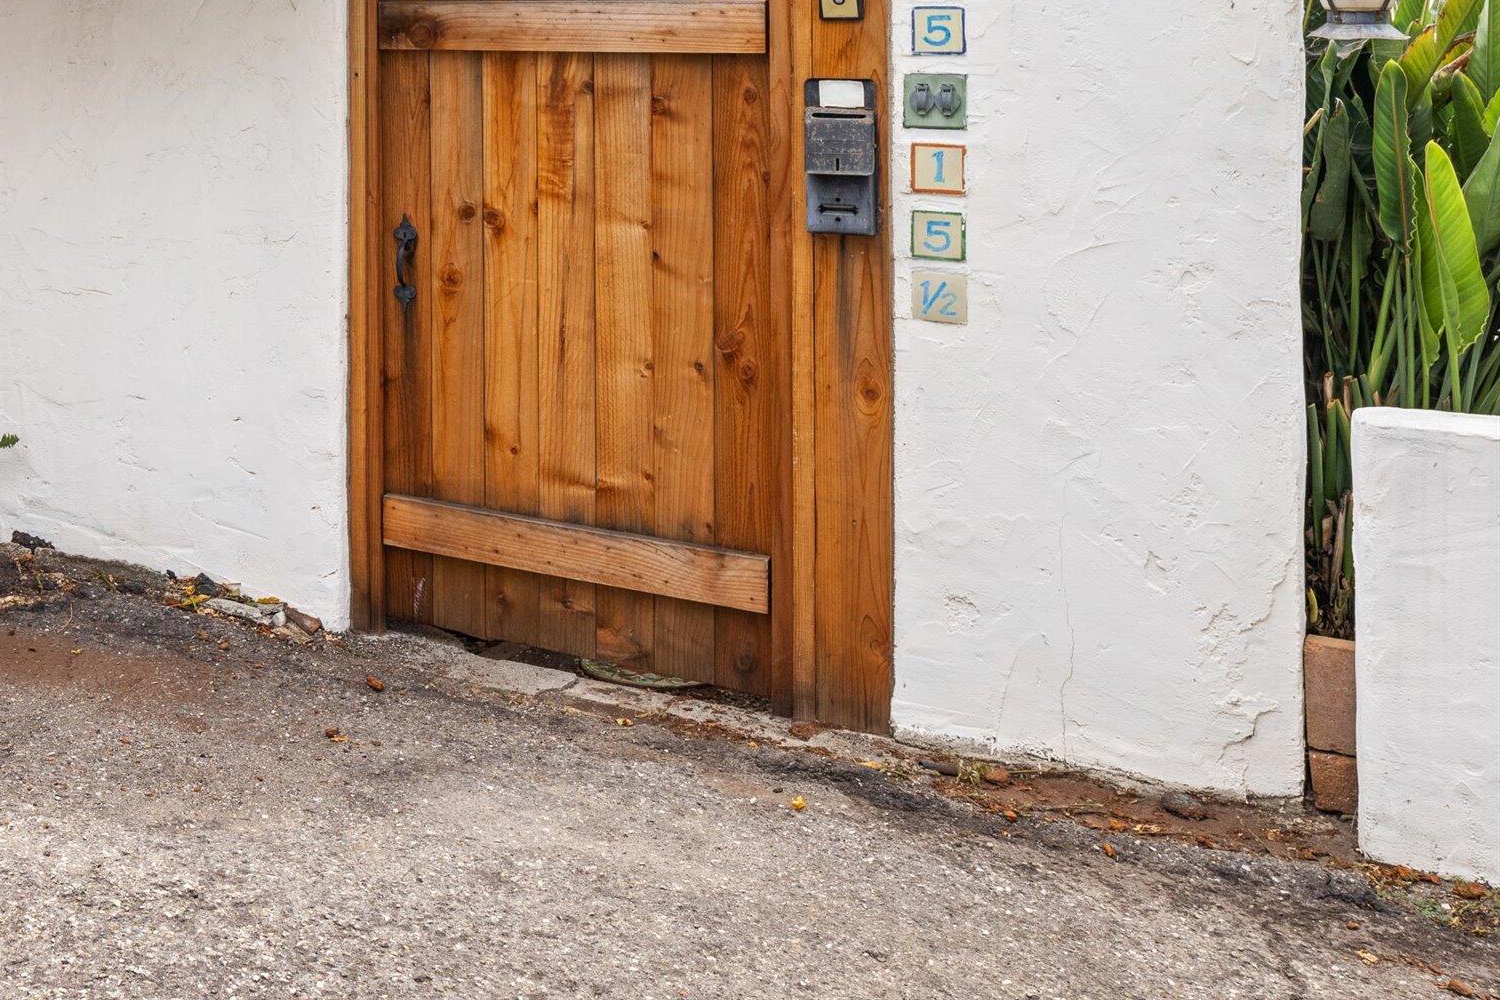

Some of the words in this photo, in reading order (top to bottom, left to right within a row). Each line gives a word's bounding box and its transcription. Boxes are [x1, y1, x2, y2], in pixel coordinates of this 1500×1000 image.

[922, 14, 952, 47] 5
[931, 150, 946, 184] 1
[923, 220, 951, 253] 5
